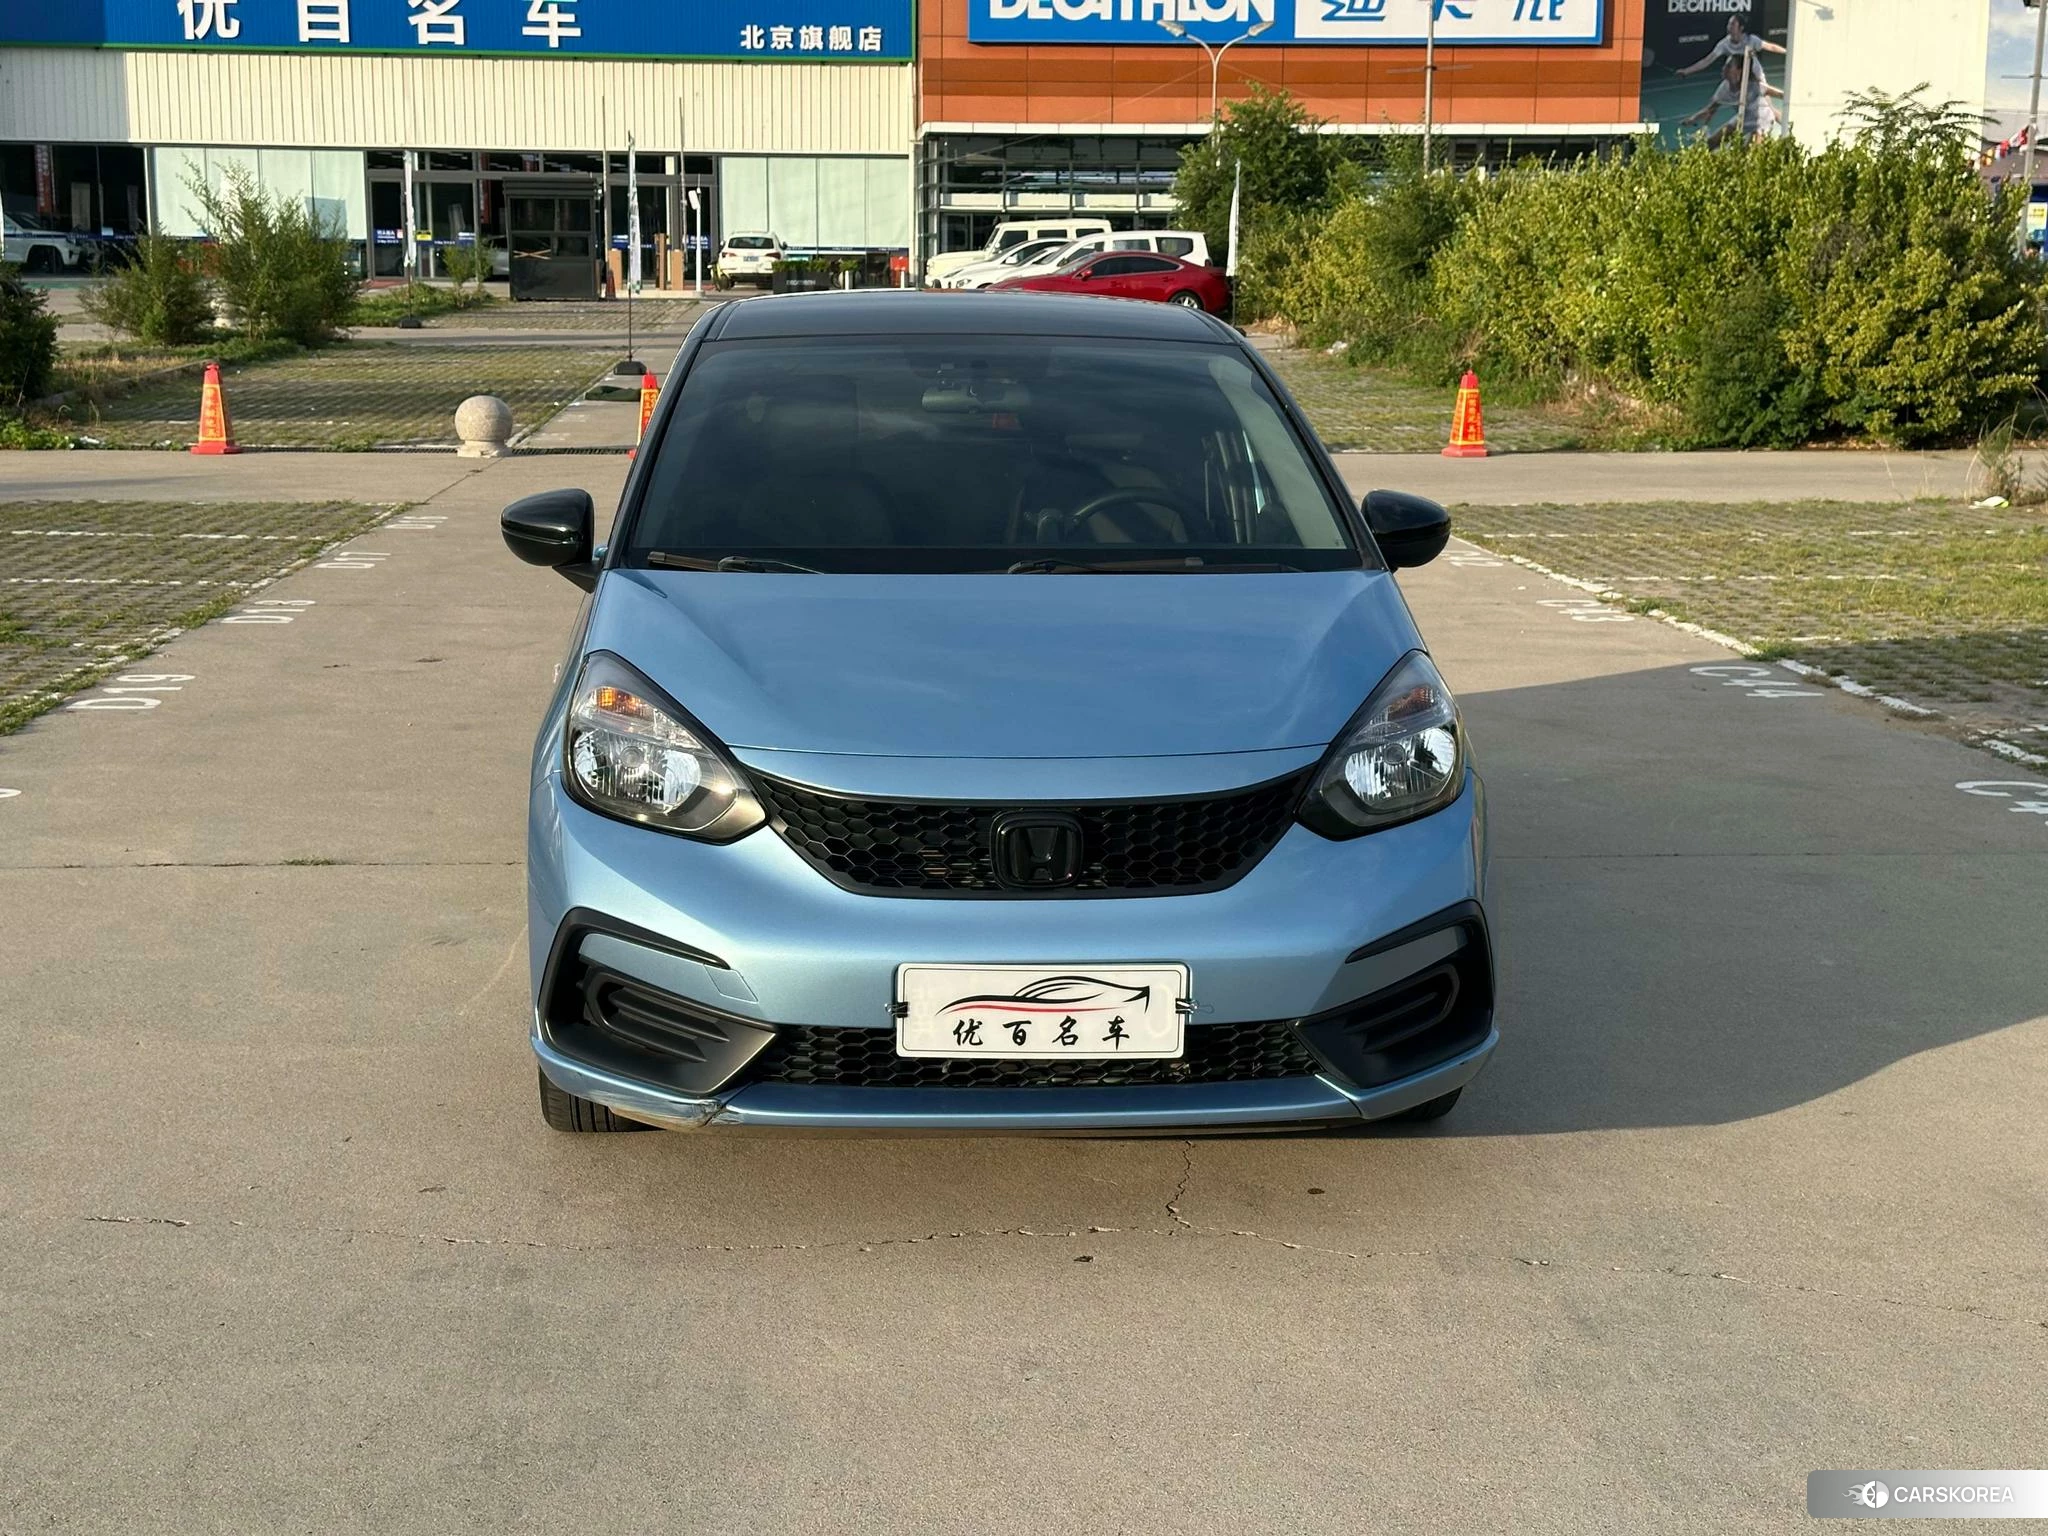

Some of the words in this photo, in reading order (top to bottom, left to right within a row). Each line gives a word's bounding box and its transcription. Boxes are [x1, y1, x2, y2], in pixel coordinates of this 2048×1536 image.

[1667, 0, 1752, 13] DECATHLON
[740, 24, 882, 51] 北京旗舰店
[65, 673, 196, 709] D19
[953, 1014, 1130, 1051] 优百名车
